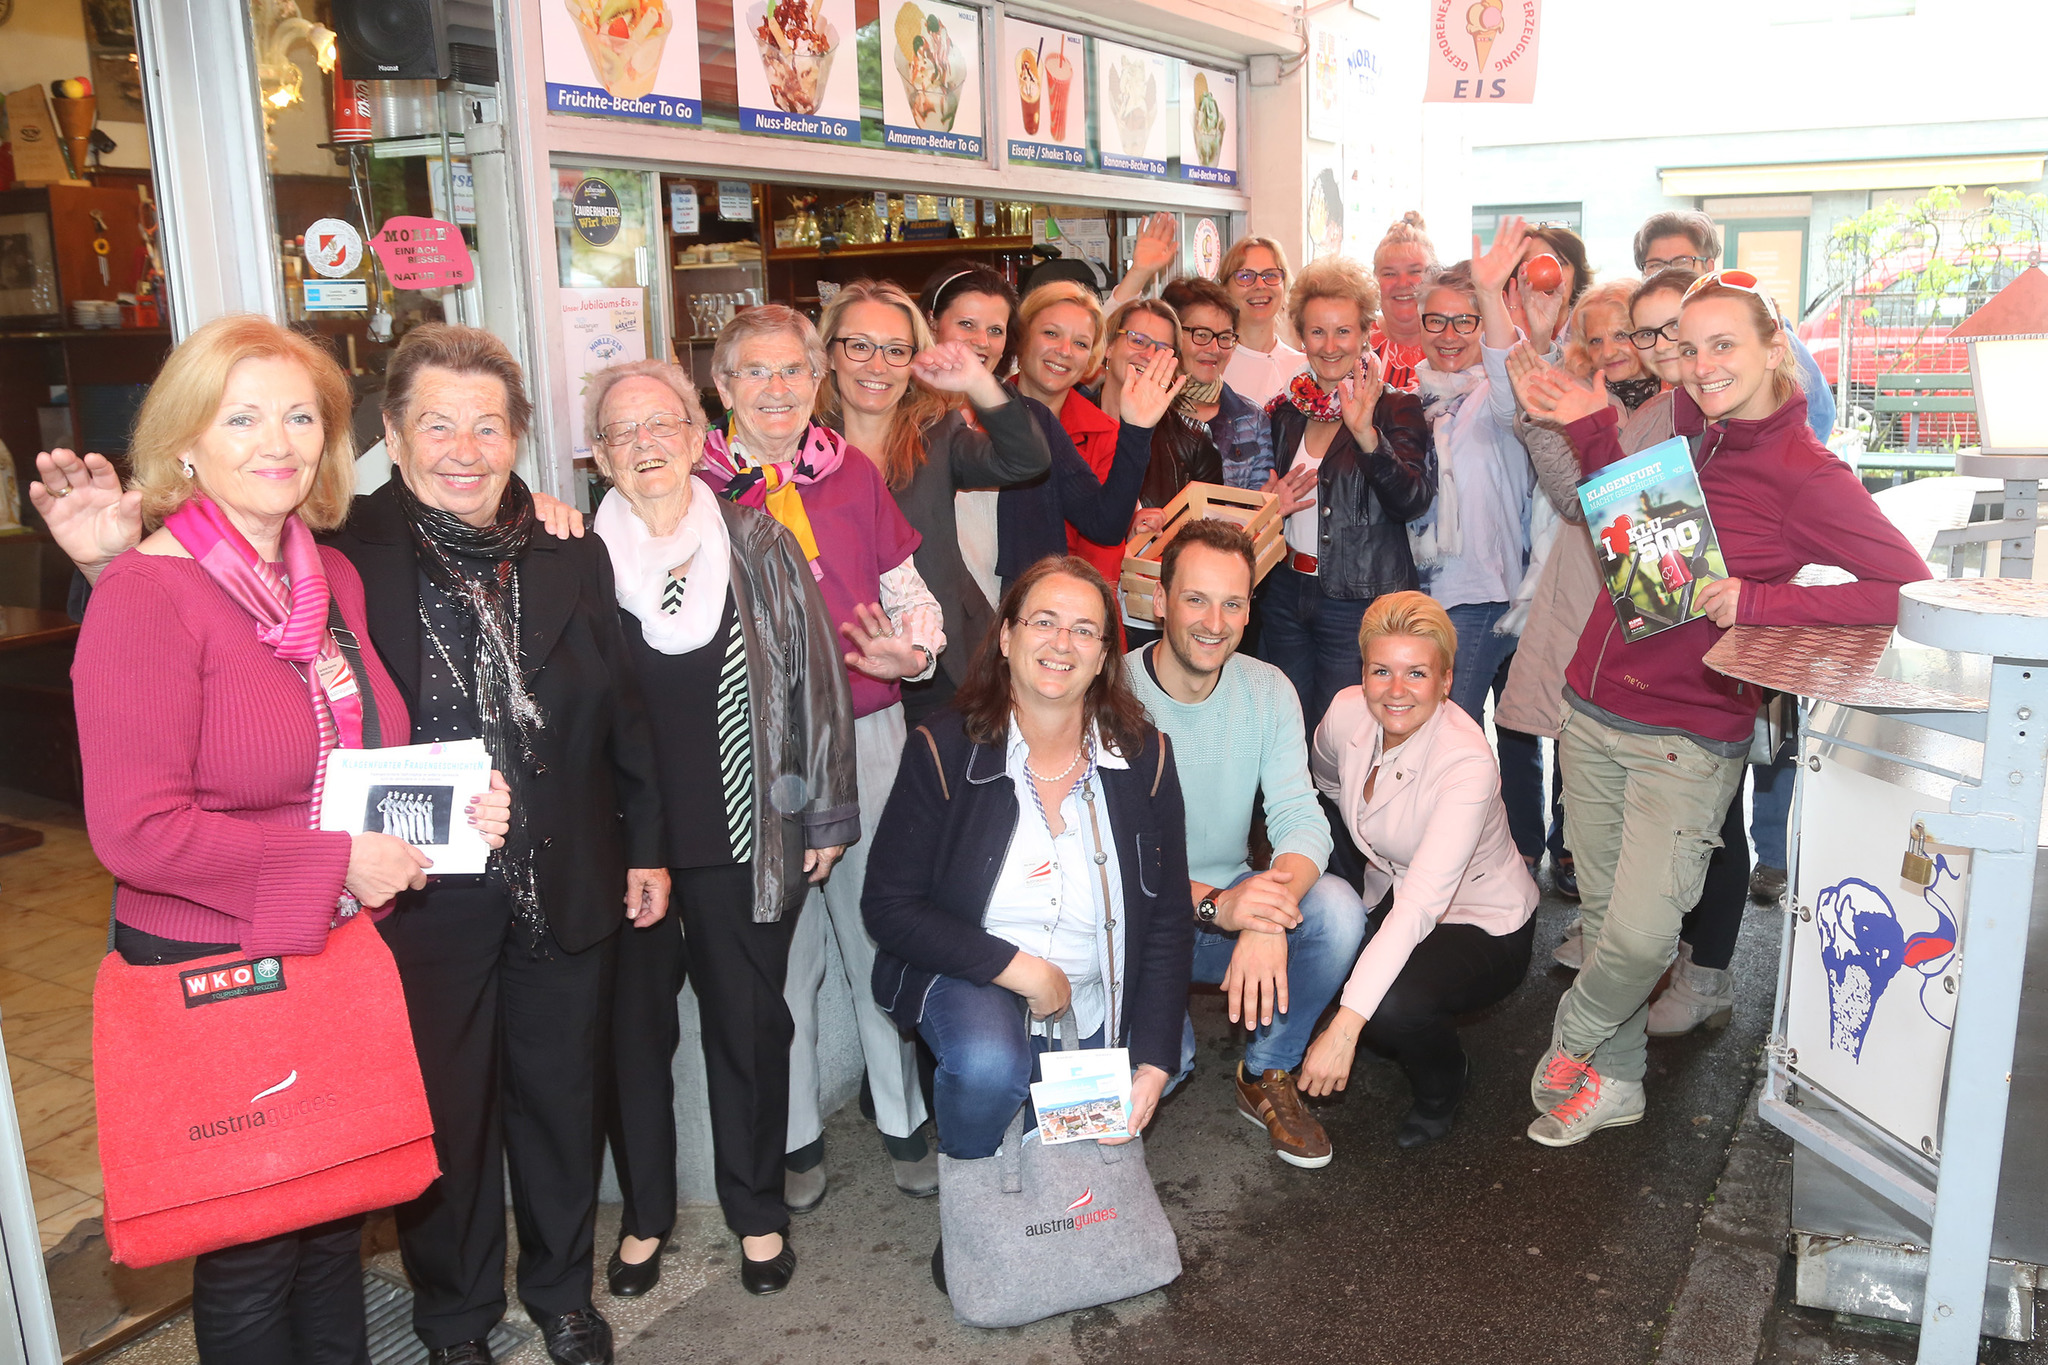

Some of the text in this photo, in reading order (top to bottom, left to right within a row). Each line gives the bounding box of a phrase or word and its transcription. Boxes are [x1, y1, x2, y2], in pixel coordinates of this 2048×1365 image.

[1436, 0, 1468, 72] GEFRORENES
[1494, 1, 1535, 72] ERZEUGUNG
[378, 64, 399, 72] Magnat
[1453, 78, 1506, 98] EIS
[558, 89, 692, 119] Früchte-Becher To Go
[755, 113, 847, 137] Nuss-Becher To Go
[887, 129, 979, 153] Amarena-Becher To Go
[1011, 143, 1035, 160] Eiscafé
[1041, 146, 1064, 161] Shakes
[1064, 149, 1072, 161] To
[1073, 151, 1083, 163] Go
[1103, 155, 1165, 174] Bananen-Becher To Go
[1188, 168, 1231, 183] Kiwi-Becher To Go
[574, 205, 619, 218] ZAUBERHAFTER
[578, 216, 599, 229] Wirt
[395, 246, 438, 255] EINFACH
[394, 271, 435, 281] NATUR
[445, 270, 463, 278] EIS
[562, 304, 579, 313] Unser
[580, 297, 631, 311] Jubiläums-Eis
[1586, 461, 1662, 502] KLAGENFURT
[1589, 472, 1666, 511] MACHT GESCHICHTE
[1601, 516, 1663, 562] I KLU
[1636, 519, 1701, 564] 500
[342, 759, 484, 771] KLAGENFURTER FRAUENGESCHICHTEN
[186, 968, 251, 994] WKO
[212, 988, 248, 999] TOURISMUS
[188, 1092, 338, 1141] austriaguides
[1025, 1207, 1118, 1237] austriaguides
